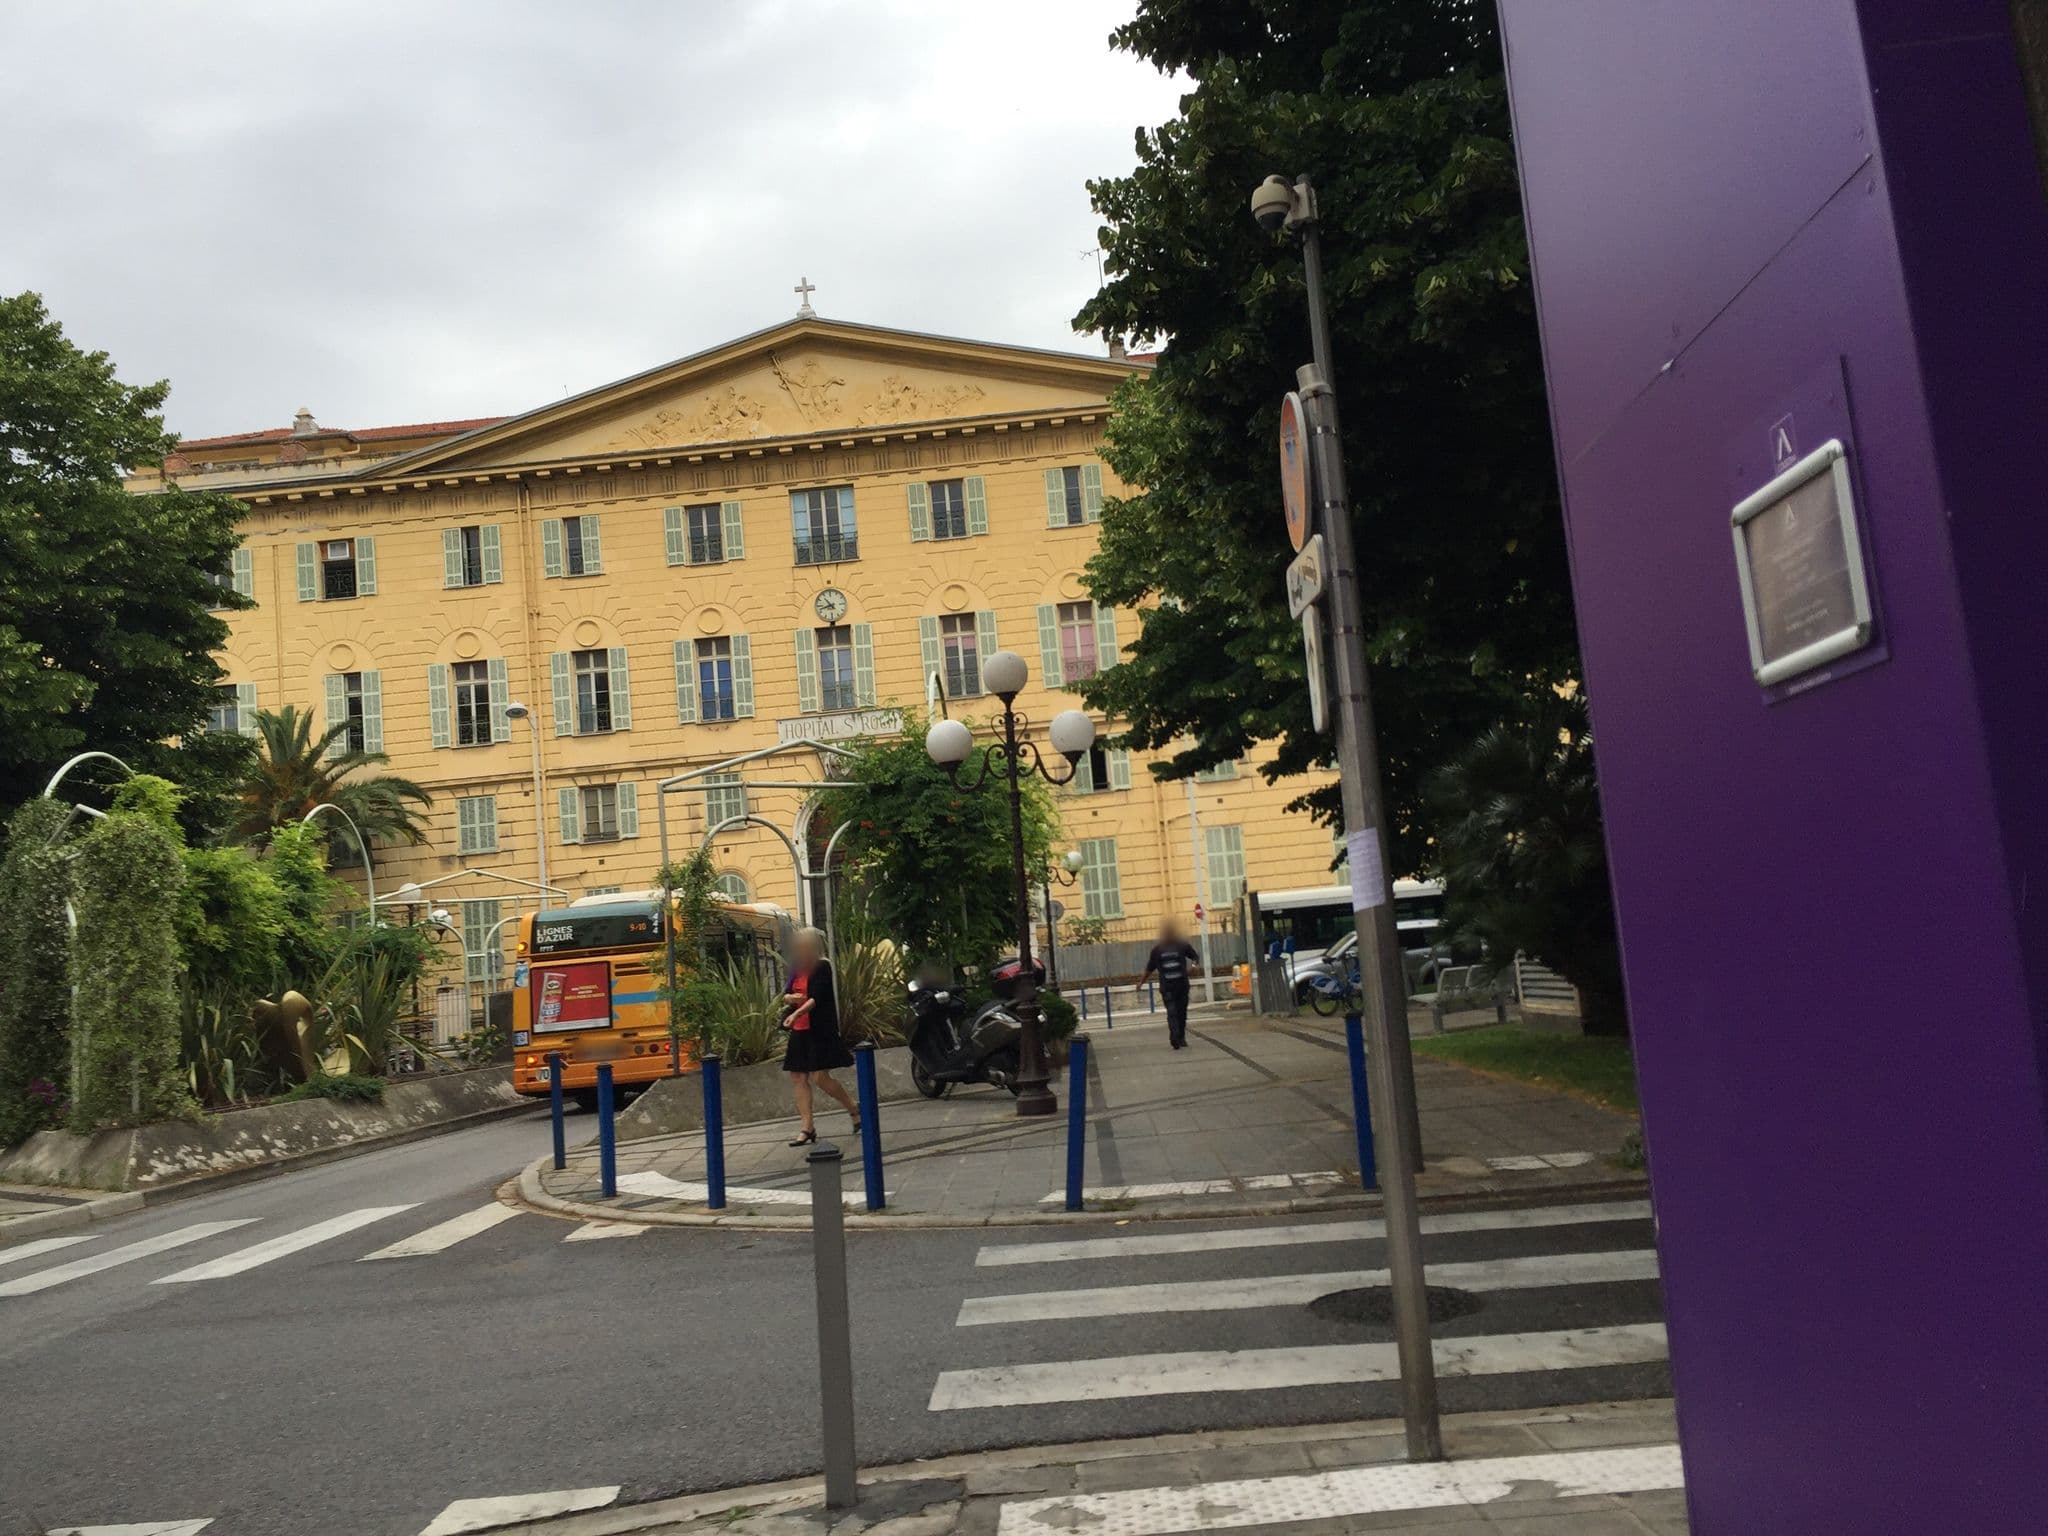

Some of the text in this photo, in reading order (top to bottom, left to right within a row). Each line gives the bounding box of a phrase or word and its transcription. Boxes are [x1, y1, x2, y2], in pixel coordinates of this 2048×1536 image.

[785, 719, 839, 739] HOPITAL
[536, 933, 574, 944] D'AZUR
[537, 1069, 550, 1080] 70
